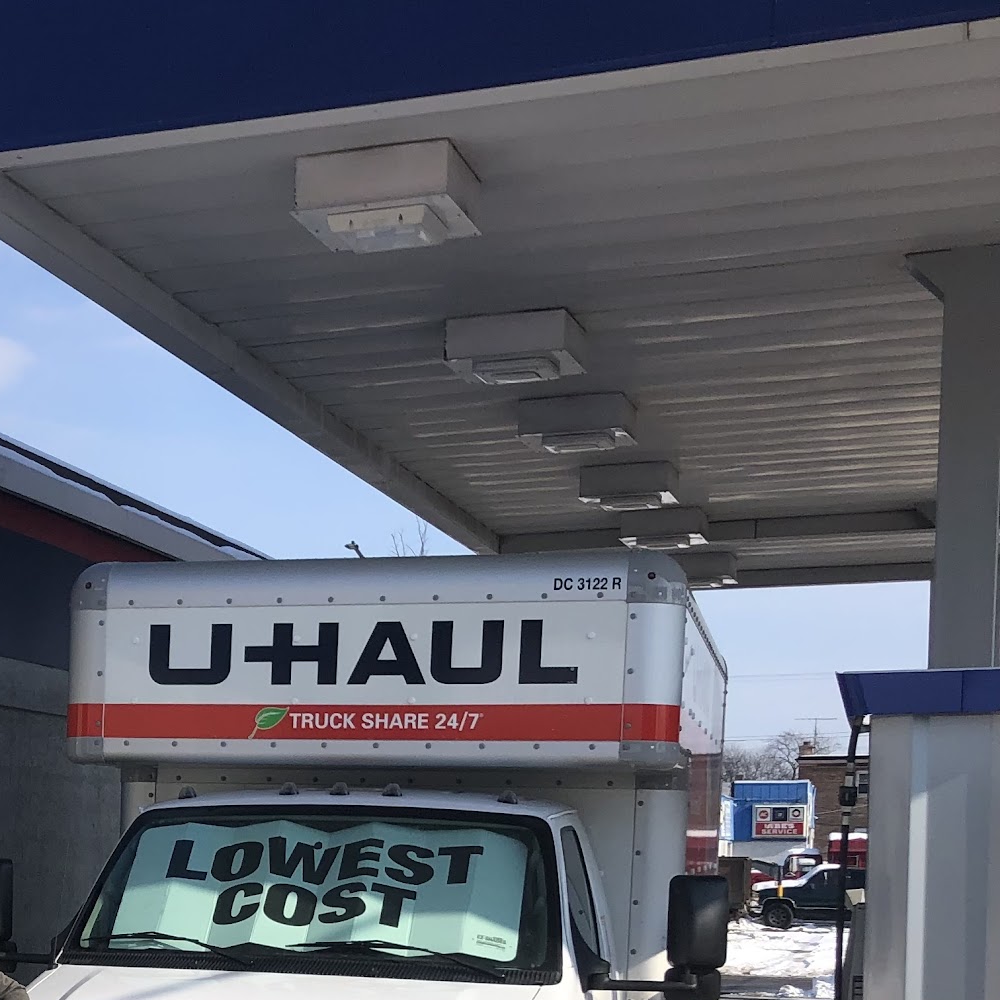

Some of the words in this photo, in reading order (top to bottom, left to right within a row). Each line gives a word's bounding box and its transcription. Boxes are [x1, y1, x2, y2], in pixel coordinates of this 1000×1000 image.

[553, 577, 574, 591] DC
[577, 577, 608, 591] 3122
[611, 577, 622, 590] R
[148, 618, 579, 686] U-HAUL
[289, 712, 358, 731] TRUCK
[361, 712, 431, 731] SHARE
[435, 712, 480, 732] 24/7
[165, 836, 484, 885] LOWEST
[212, 882, 417, 928] COST
